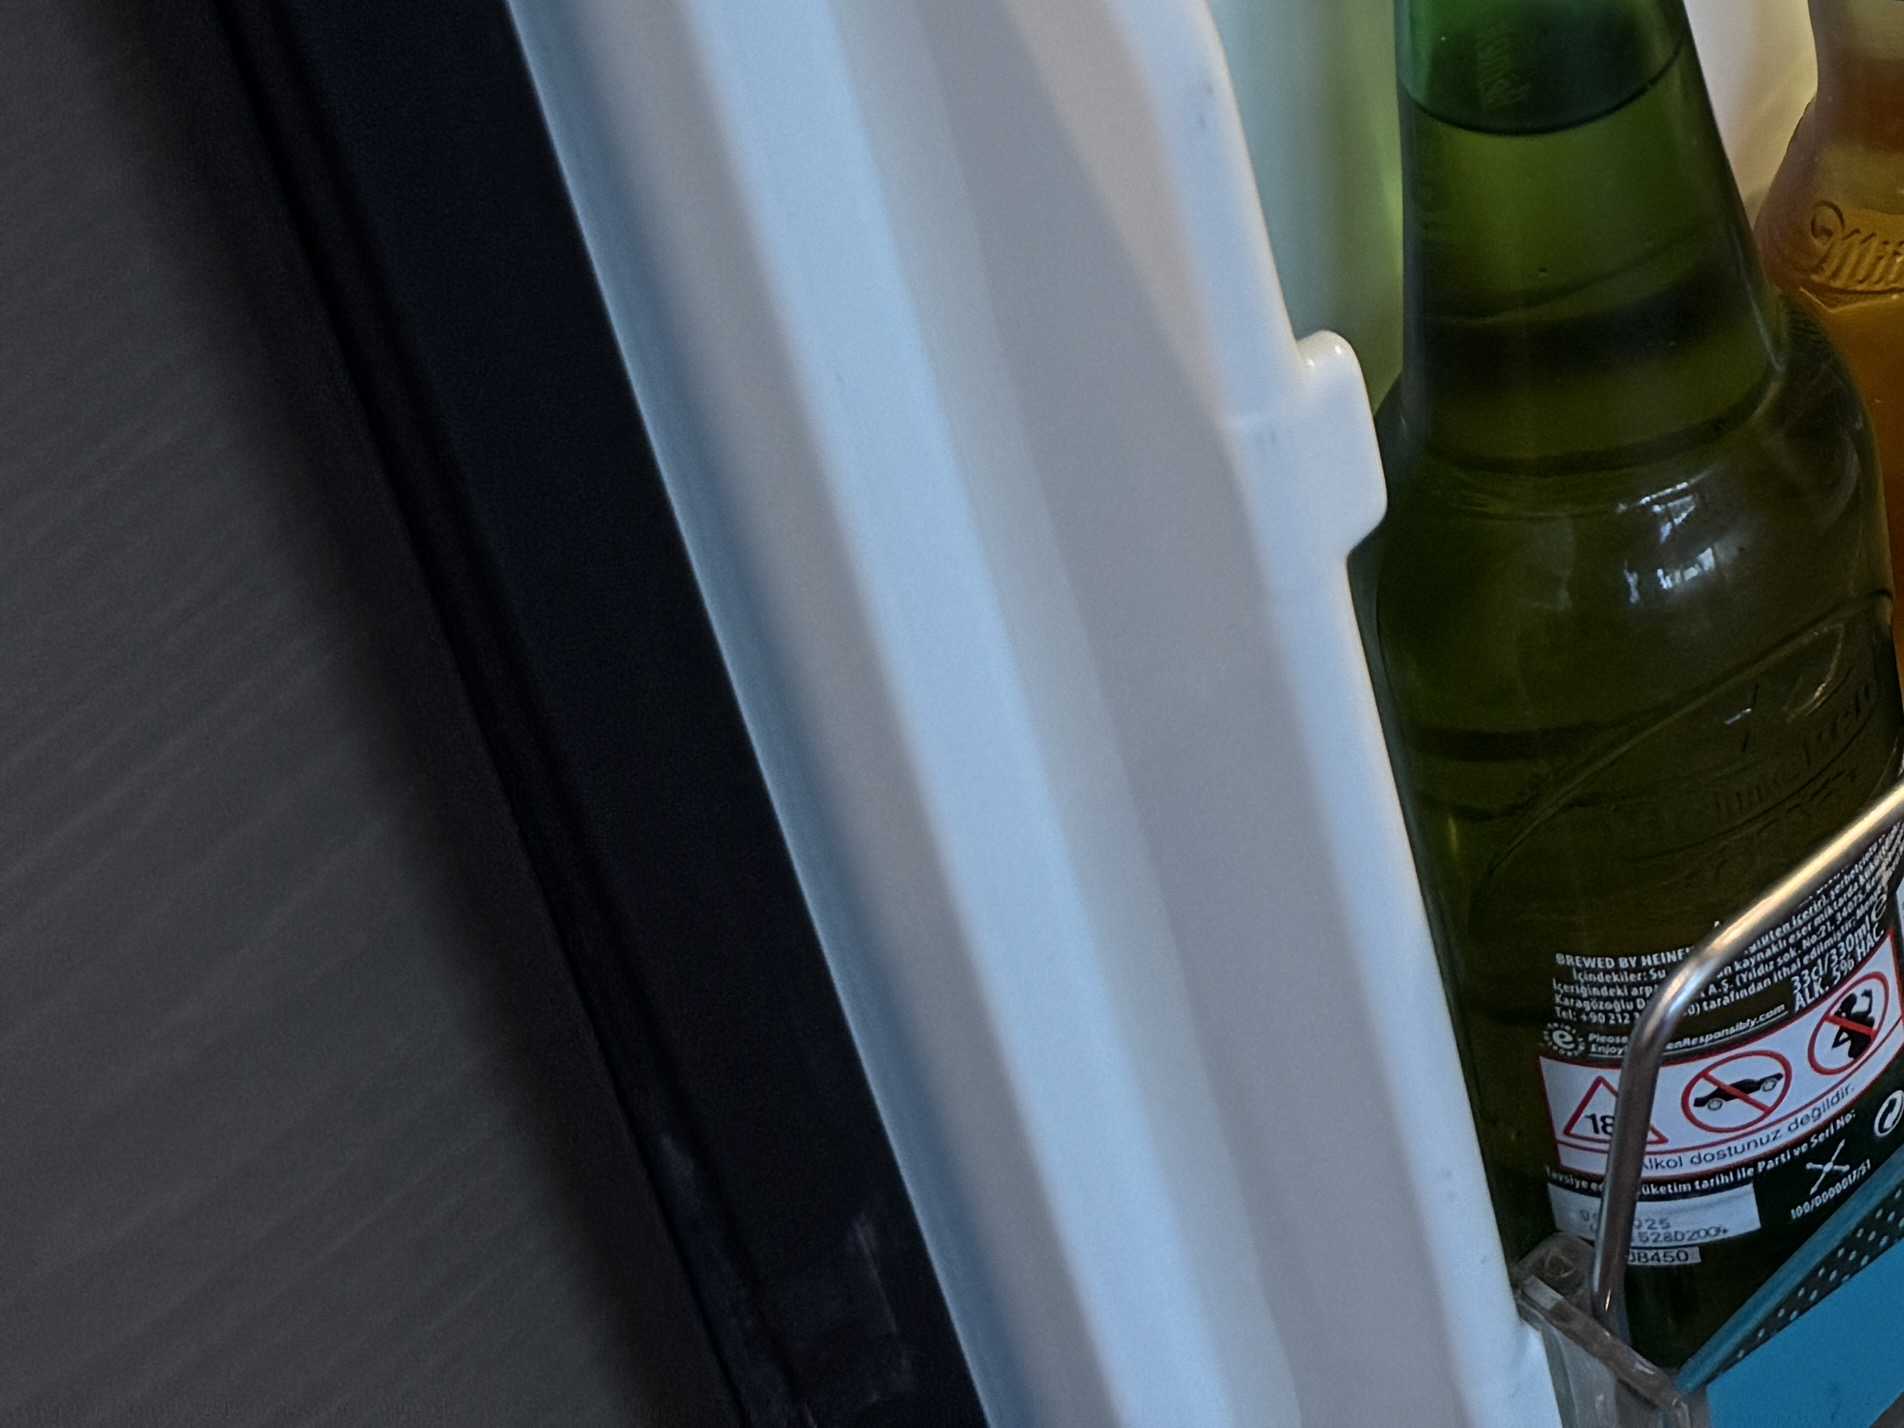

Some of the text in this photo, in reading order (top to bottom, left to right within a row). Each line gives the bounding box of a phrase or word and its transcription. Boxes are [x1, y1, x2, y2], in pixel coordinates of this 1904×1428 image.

[1555, 952, 1637, 969] BREWED BY
[1649, 969, 1667, 981] Su
[1793, 975, 1831, 1014] ALK.
[1855, 922, 1886, 962] HAC.
[1554, 1006, 1577, 1020] Tel:
[1608, 1011, 1632, 1025] 212
[1701, 978, 1773, 1012] tarafından
[1631, 984, 1658, 996] arp
[1689, 1128, 1784, 1167] dostunuz
[1786, 1083, 1856, 1133] değildir.
[1641, 1178, 1692, 1195] üketim
[1694, 1173, 1735, 1192] tarihi
[1756, 1148, 1791, 1173] Parti
[1792, 1143, 1809, 1157] ve
[1809, 1124, 1834, 1147] Seri
